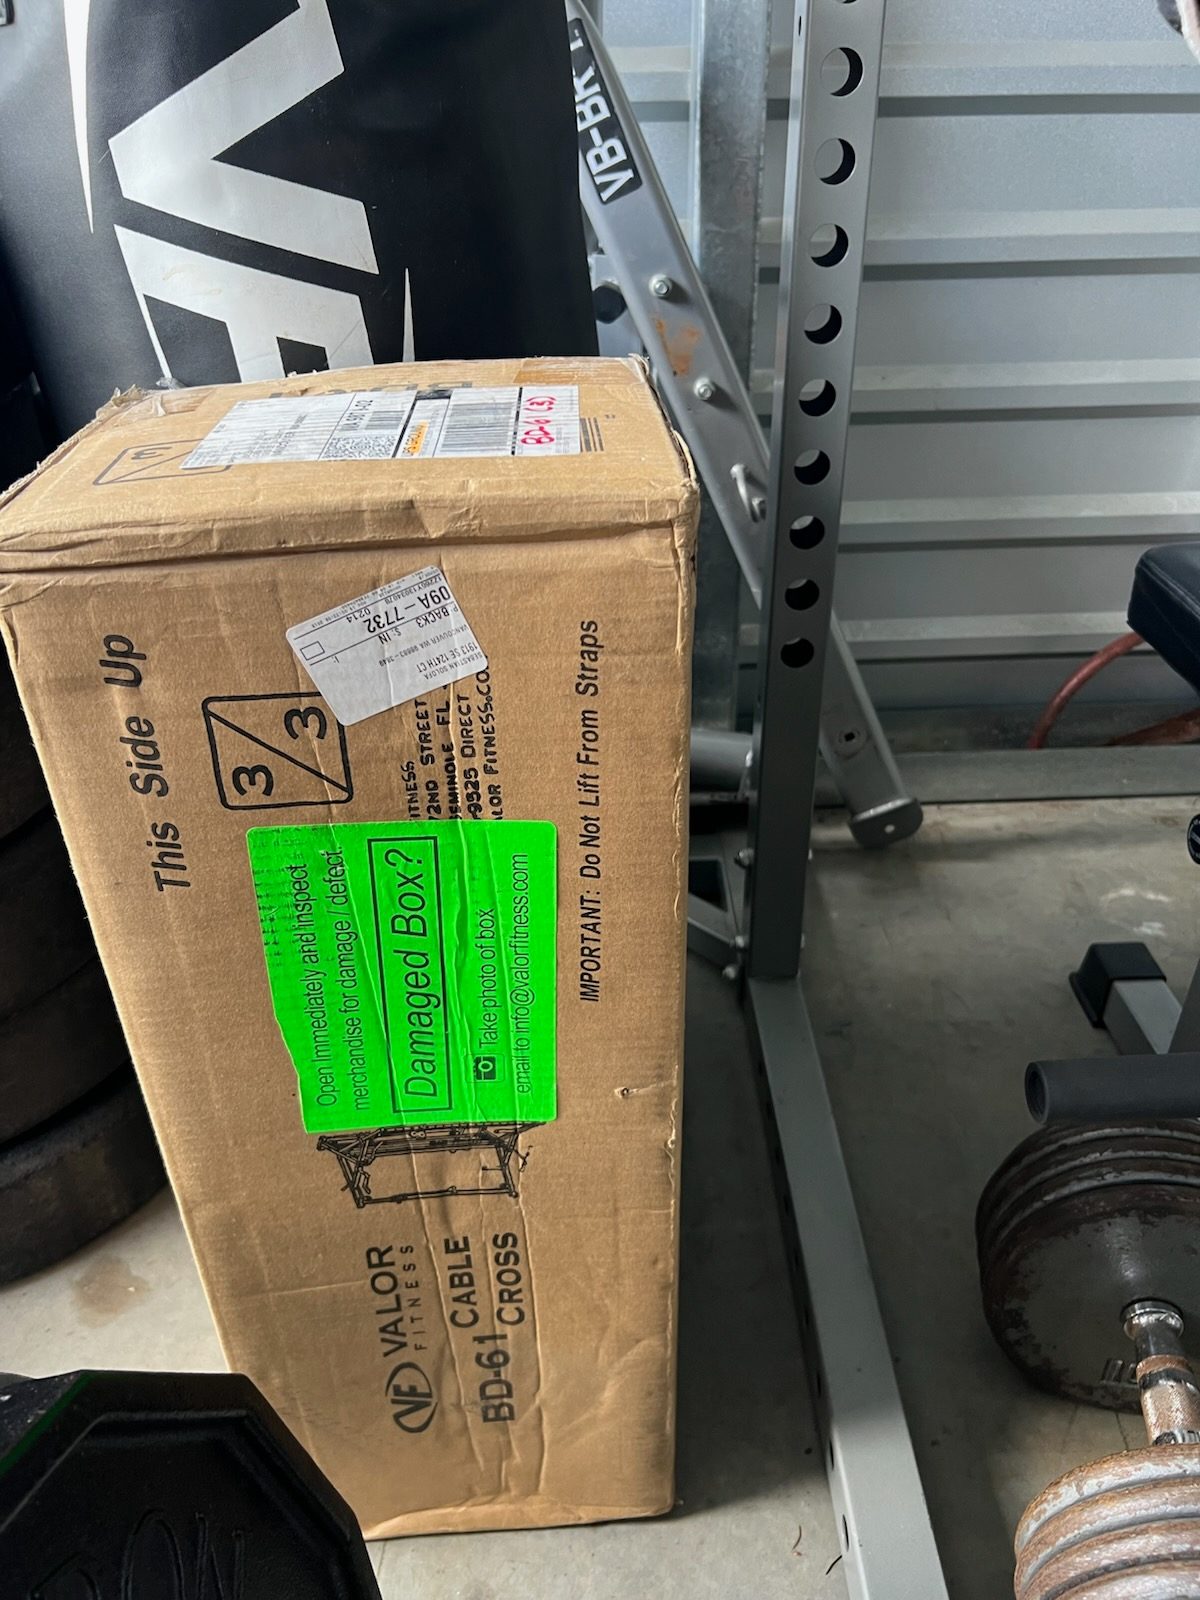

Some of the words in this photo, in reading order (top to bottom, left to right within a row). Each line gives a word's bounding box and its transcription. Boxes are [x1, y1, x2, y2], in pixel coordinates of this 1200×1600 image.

[346, 607, 371, 624] 0214
[420, 584, 451, 609] 09A
[363, 606, 405, 634] 7732
[416, 606, 450, 628] BACK3
[379, 633, 393, 645] IN
[446, 649, 460, 661] SE
[460, 641, 478, 656] 1913
[99, 634, 147, 688] Up
[416, 663, 428, 674] CT
[427, 653, 449, 670] 124TH
[449, 652, 484, 671] SEBASTIAN
[575, 620, 605, 697] Straps
[283, 706, 328, 740] 3
[414, 698, 436, 766] STREET
[436, 700, 451, 726] FL
[457, 694, 477, 758] DIRECT
[476, 665, 499, 775] FITNESS.CO
[119, 715, 169, 797] Side
[576, 709, 599, 766] From
[231, 764, 274, 796] 3
[401, 760, 421, 820] ITNESS
[576, 772, 600, 807] Lift
[578, 815, 601, 848] Not
[146, 821, 191, 892] This
[579, 853, 601, 879] Do
[286, 863, 318, 929] inspect
[384, 847, 428, 938] Box?
[475, 908, 496, 937] box
[291, 929, 319, 965] and
[334, 920, 359, 990] damage
[475, 936, 496, 960] of
[508, 853, 535, 1033] info@valorfitness.com
[580, 890, 602, 1002] IMPORTANT:
[338, 990, 360, 1015] for
[478, 963, 503, 1012] photo
[300, 968, 331, 1062] Immediately
[393, 949, 442, 1098] Damaged
[479, 1012, 498, 1049] Take
[513, 1036, 531, 1051] to
[343, 1015, 370, 1111] merchandise
[511, 1057, 531, 1094] email
[316, 1069, 341, 1107] Open
[400, 1244, 428, 1351] FITNESS
[444, 1235, 480, 1329] CABLE
[492, 1231, 525, 1326] CROSS
[366, 1245, 408, 1358] VALOR
[472, 1333, 515, 1424] BD-61
